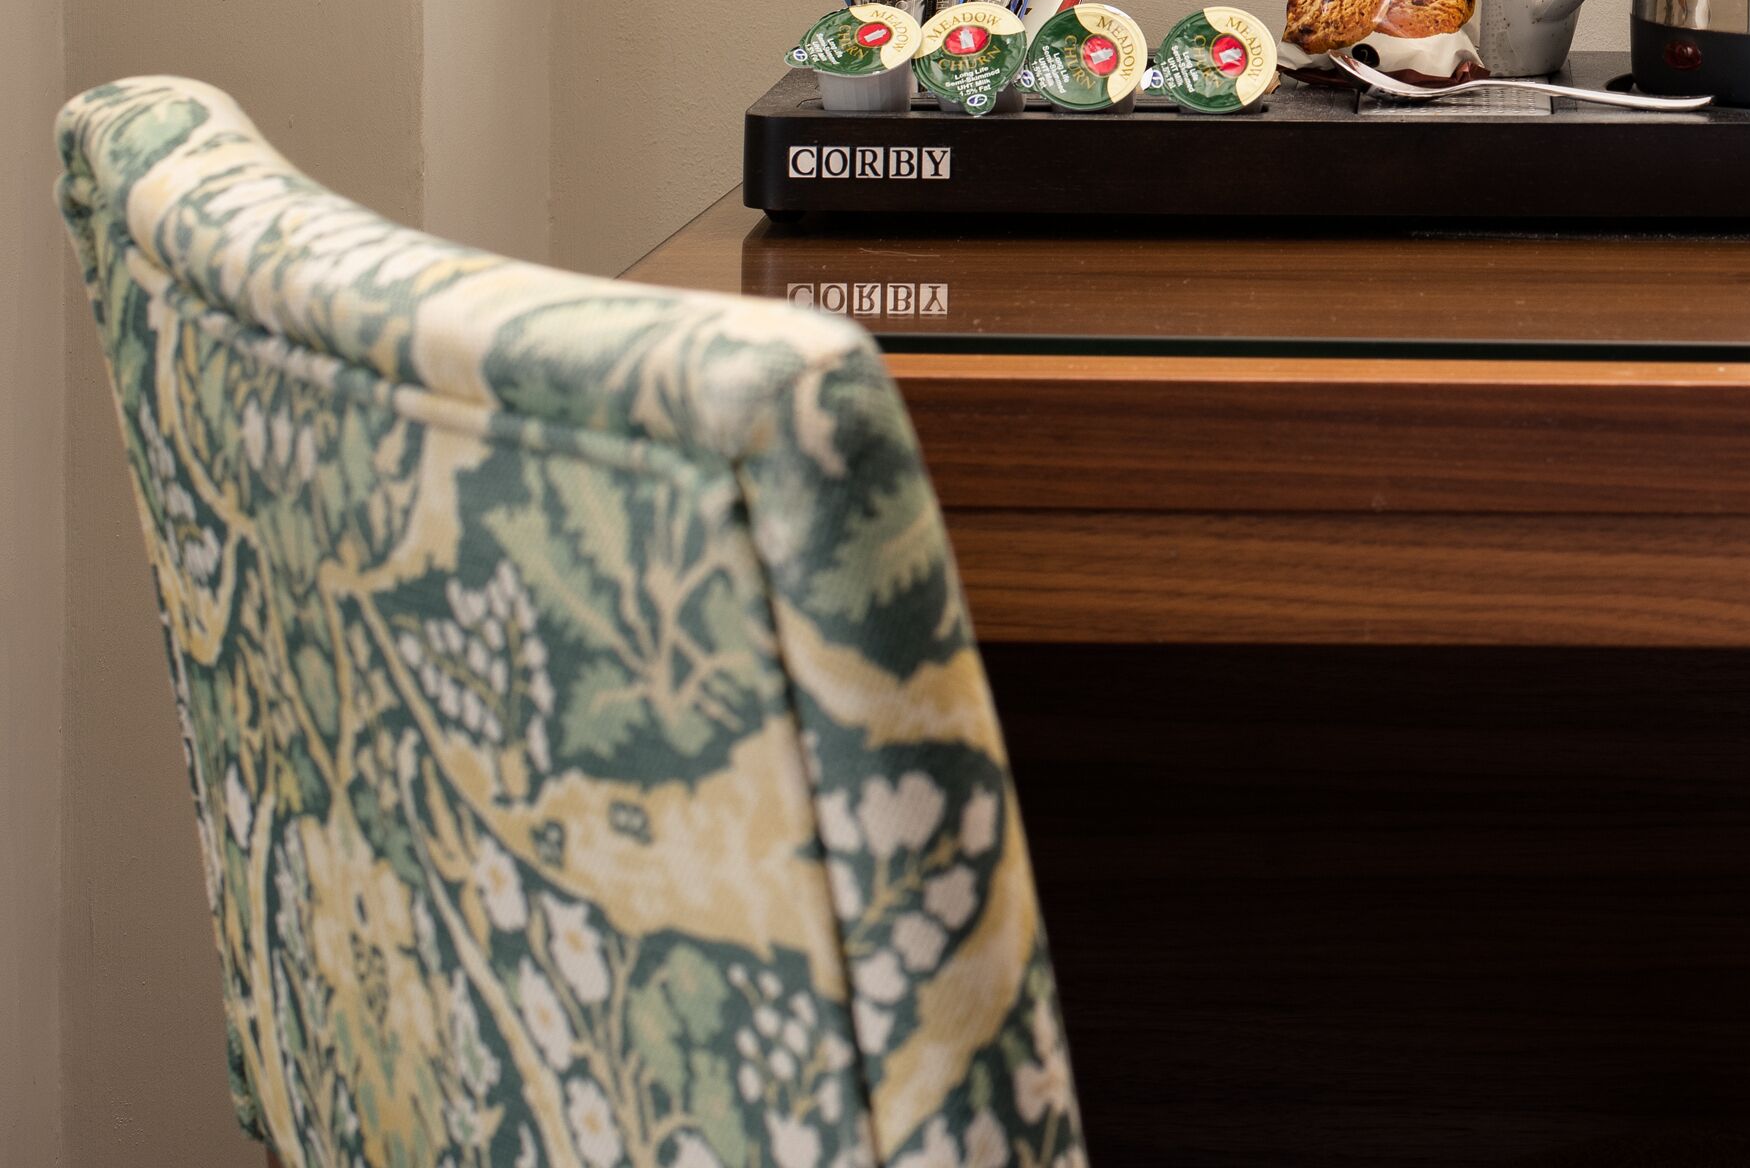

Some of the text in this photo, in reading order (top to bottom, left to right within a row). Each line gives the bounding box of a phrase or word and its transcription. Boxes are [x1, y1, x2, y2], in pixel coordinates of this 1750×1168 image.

[838, 23, 869, 61] CHURN
[871, 9, 908, 54] MEADOW
[926, 11, 1002, 43] MEADOW
[1225, 16, 1264, 79] MEADOW
[938, 44, 1002, 73] CHURN
[1064, 34, 1096, 90] CHURN
[1096, 15, 1136, 81] MEADOW
[1193, 34, 1225, 89] CHURN
[954, 66, 989, 80] Long Life
[790, 147, 950, 178] CORBY
